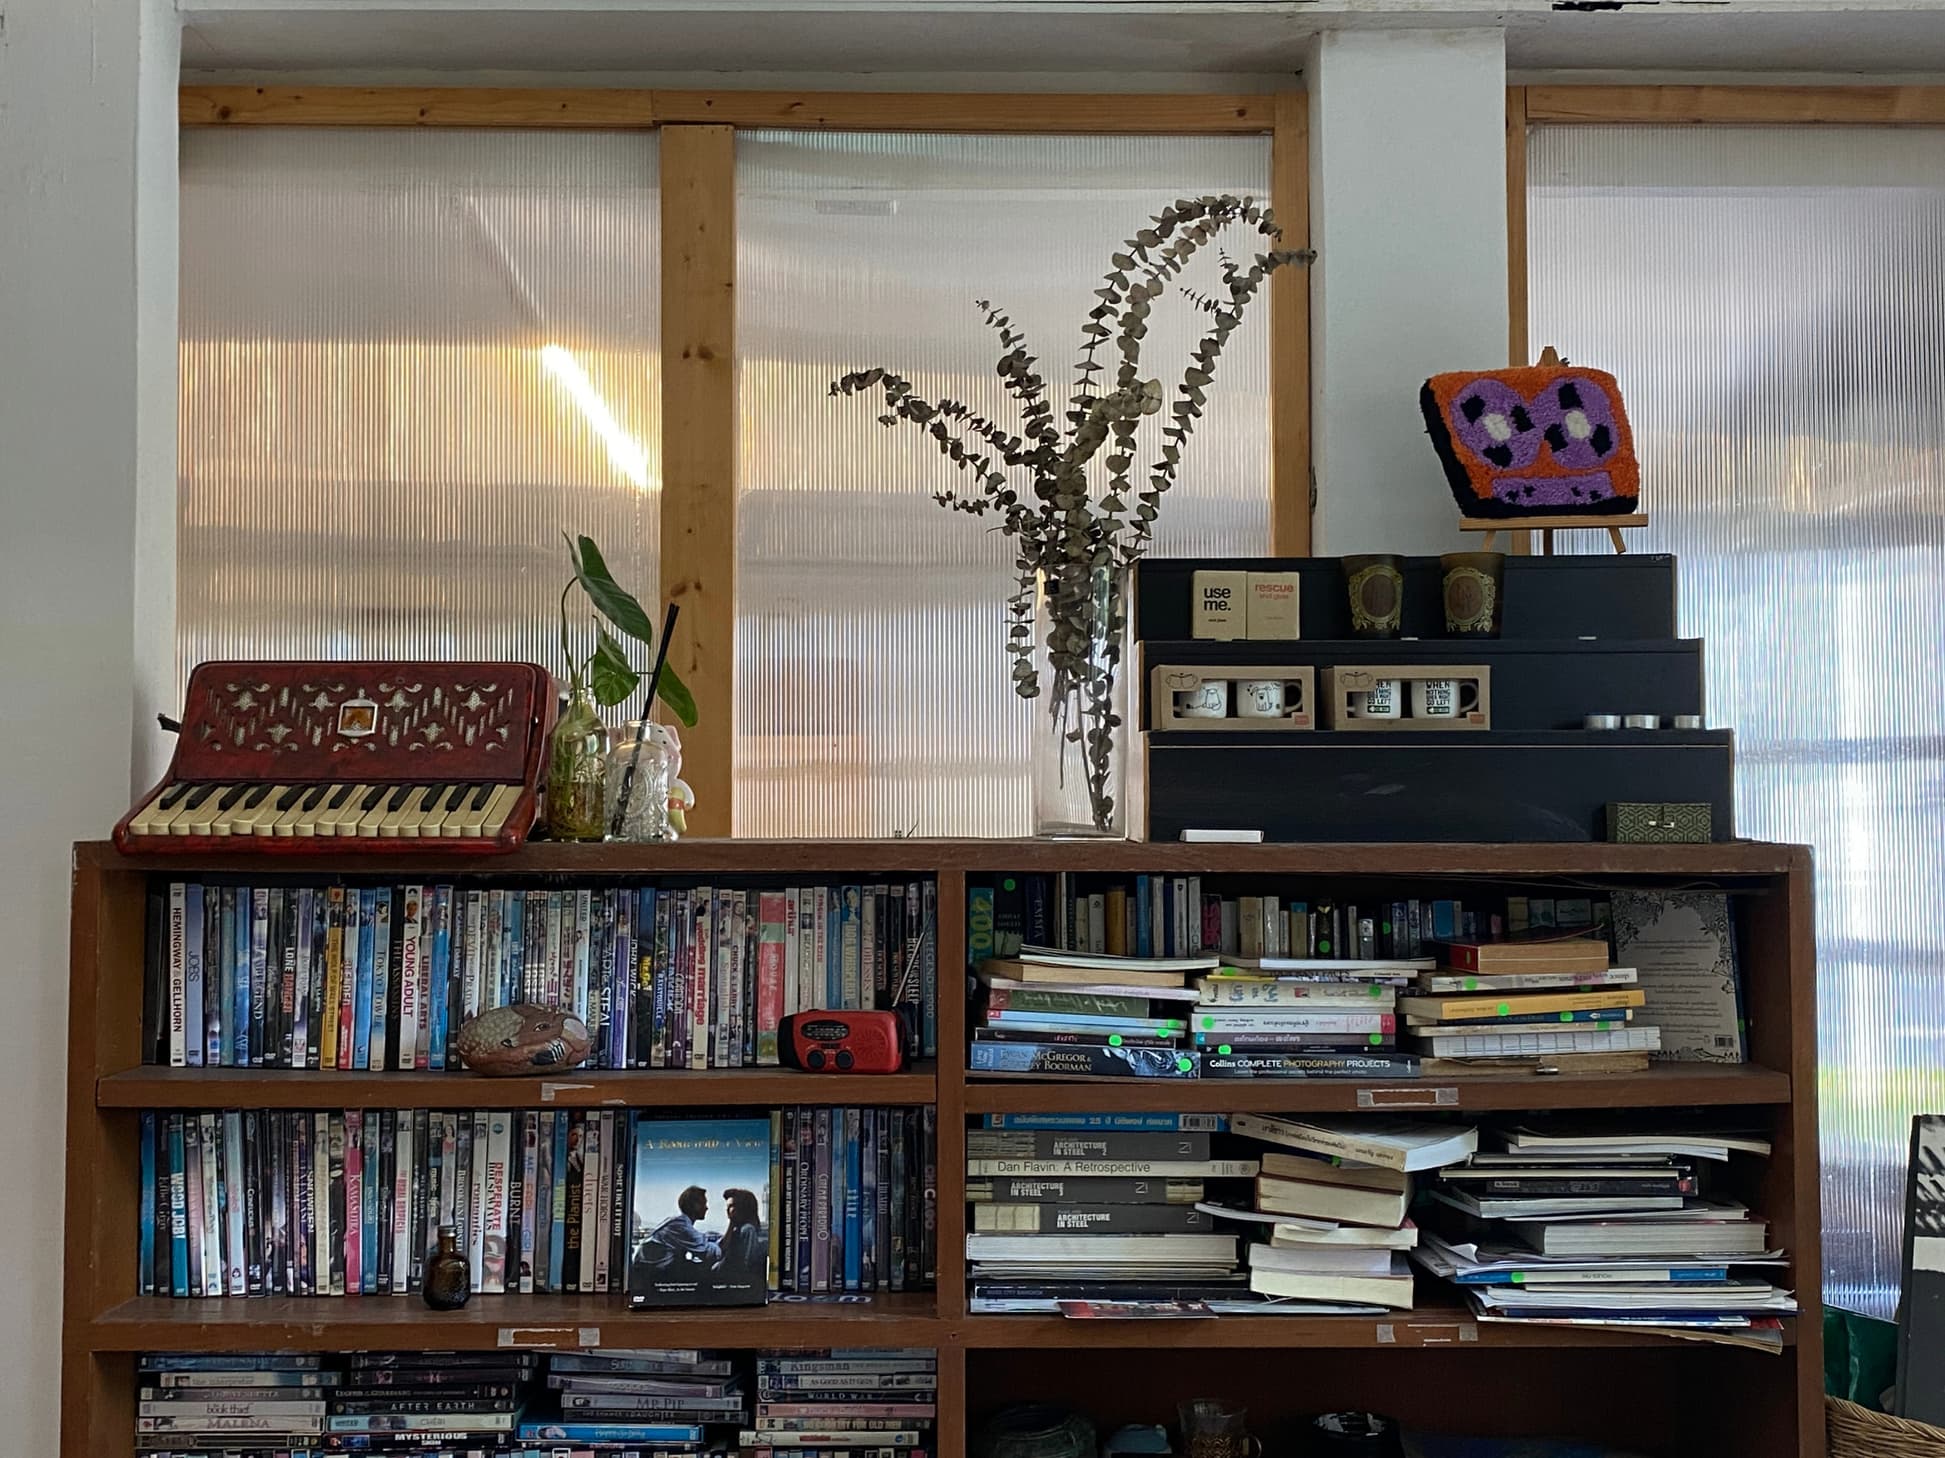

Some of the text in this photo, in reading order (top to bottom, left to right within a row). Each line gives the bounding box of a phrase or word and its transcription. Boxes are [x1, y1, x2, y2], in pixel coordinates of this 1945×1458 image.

[1204, 587, 1231, 598] use
[1255, 584, 1293, 592] rescue
[1204, 600, 1232, 611] me.
[1426, 680, 1450, 688] WHEN
[788, 900, 796, 936] arthur
[188, 950, 200, 982] JOBS
[285, 947, 295, 972] LONE
[394, 939, 402, 962] THE
[844, 924, 857, 1000] DOG WHISPERER
[173, 907, 182, 1032] HEMINGWAY GELLHORN
[404, 936, 416, 1017] YOUNG ADULT
[863, 944, 873, 992] DRESSES
[926, 942, 934, 1018] LEGEND 1900
[374, 950, 386, 1028] TOKYO TOWER
[464, 975, 474, 1006] PRADA
[328, 1006, 336, 1032] STREET
[420, 1002, 428, 1030] ARTS
[1044, 1061, 1092, 1072] BOORMAN
[1209, 1060, 1390, 1068] Collins COMPLETE PHOTOGRAPHY PROJECTS
[997, 1161, 1020, 1172] Dan
[1063, 1162, 1072, 1172] A
[1076, 1162, 1151, 1174] Retrospective
[1102, 1148, 1107, 1156] 2
[430, 1168, 438, 1192] music
[458, 1170, 466, 1215] BROOKLYN
[583, 1172, 598, 1214] duets
[170, 1172, 186, 1238] WOOD JOB!
[307, 1170, 316, 1232] SNOWDEN
[494, 1162, 503, 1230] DESPERATE
[510, 1181, 522, 1224] BURNT
[600, 1174, 609, 1224] WAR HORSE
[800, 1162, 810, 1242] ORDINARY PEOPLE
[924, 1164, 936, 1230] CHICAGO
[566, 1183, 581, 1248] the Pianist
[615, 1208, 622, 1217] IT
[818, 1202, 828, 1240] PARADISO
[790, 1362, 850, 1372] Kingsman
[206, 1404, 249, 1414] book thief
[390, 1402, 474, 1410] AFTER EARTH
[808, 1392, 872, 1400] WORLD WAR
[394, 1433, 468, 1441] MYSTERIOUS
